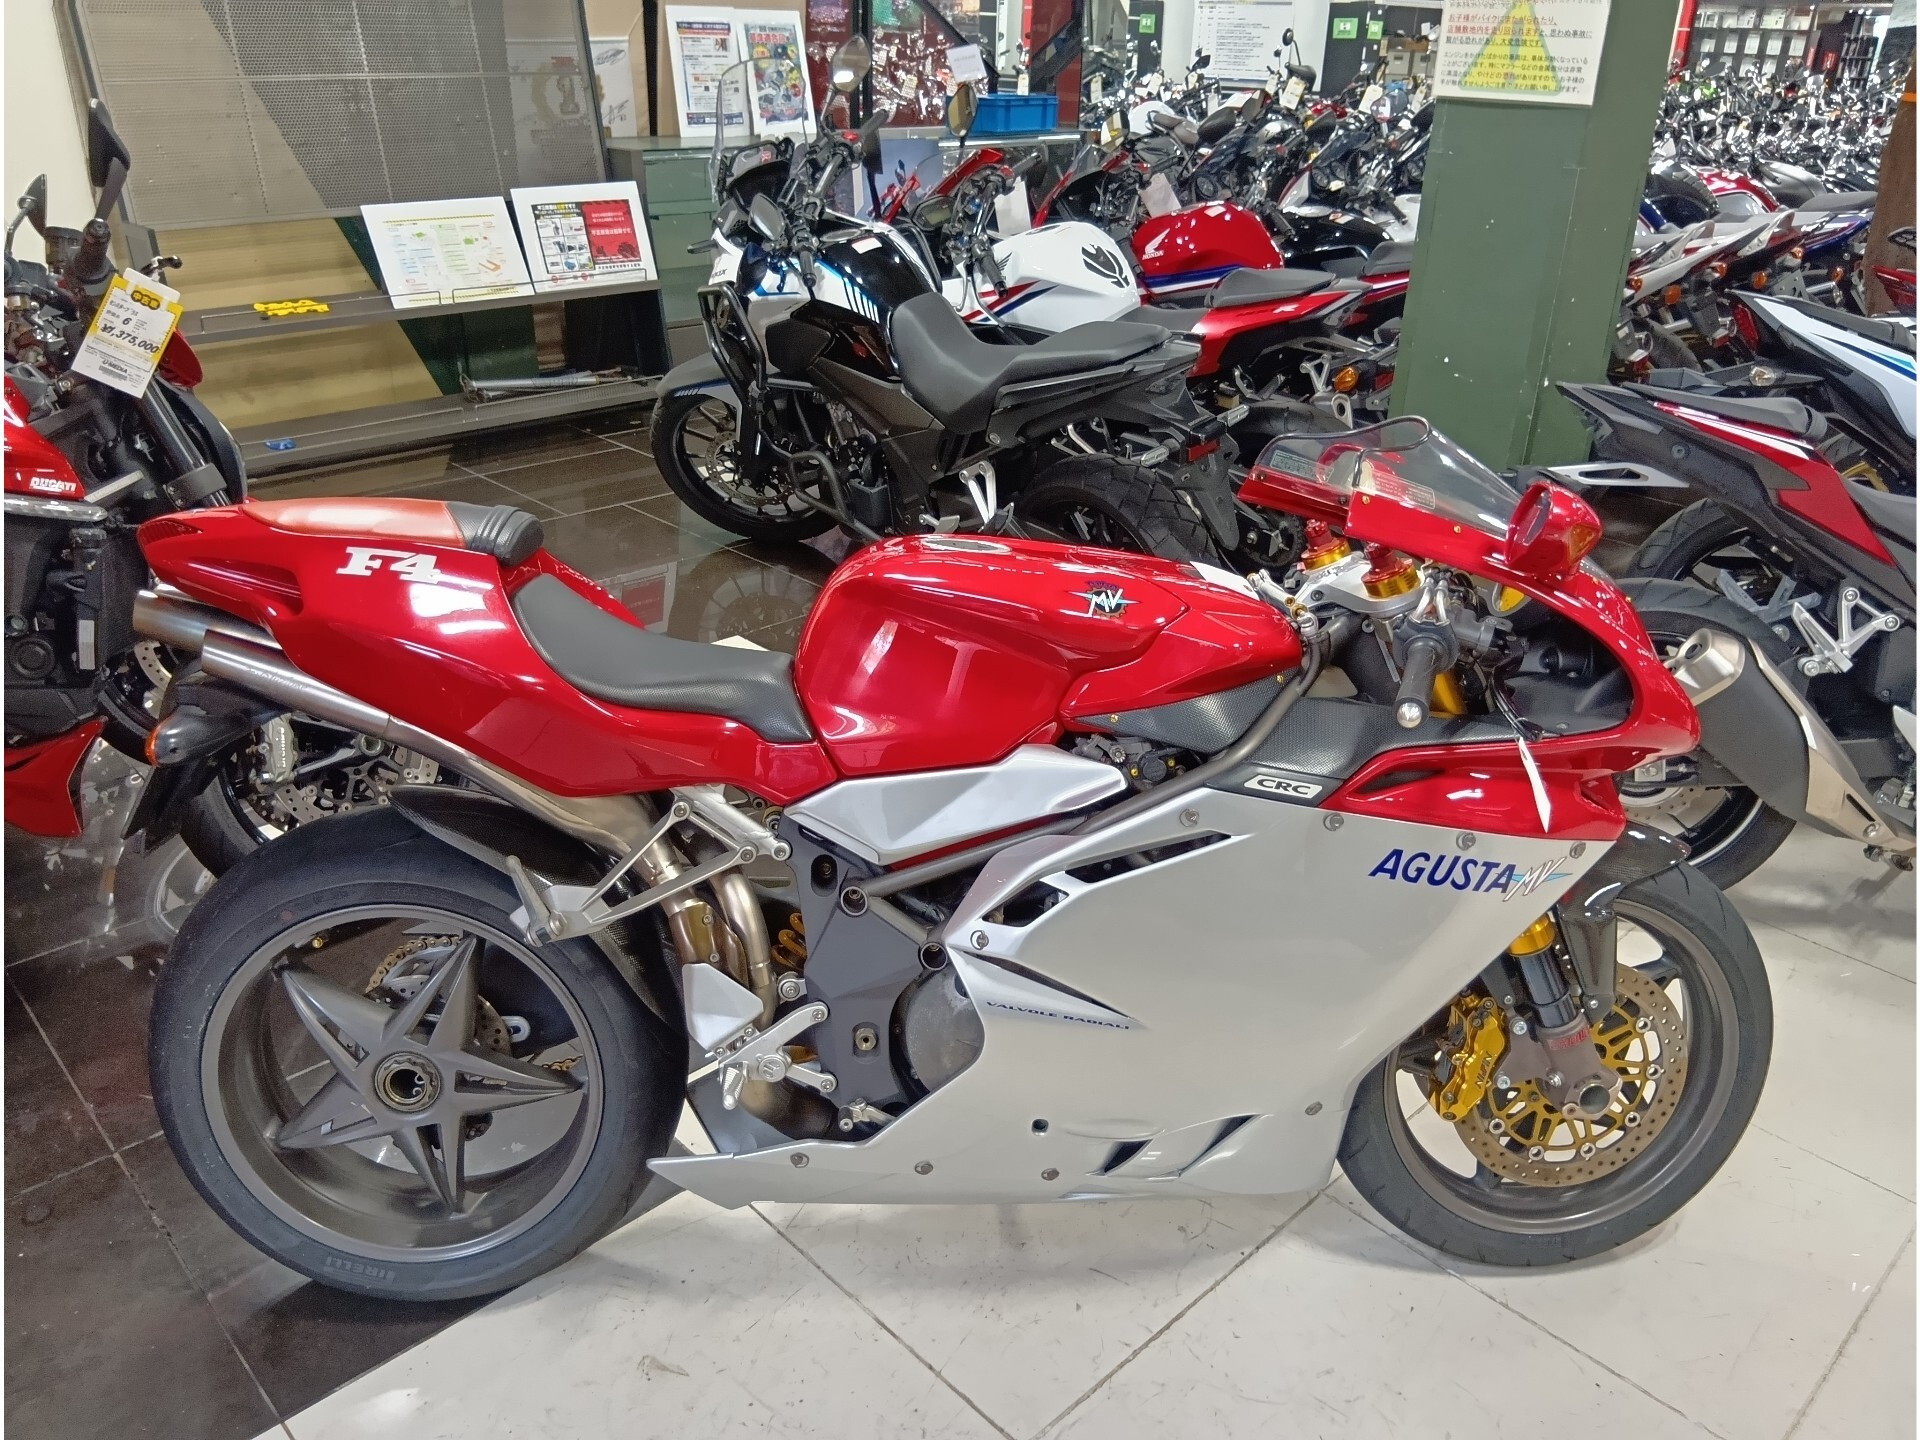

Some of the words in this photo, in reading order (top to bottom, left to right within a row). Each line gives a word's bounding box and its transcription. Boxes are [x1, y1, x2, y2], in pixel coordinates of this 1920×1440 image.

[122, 317, 132, 326] 6
[30, 477, 76, 491] DUCATI
[336, 546, 438, 584] F4
[1087, 588, 1124, 617] MV
[1257, 779, 1311, 795] CRC
[1368, 848, 1516, 894] AGUSTA
[1502, 856, 1567, 902] MV
[986, 1001, 1057, 1018] VALVOLE
[1063, 1015, 1129, 1030] RADIALI
[324, 1256, 396, 1282] PIRELLI
